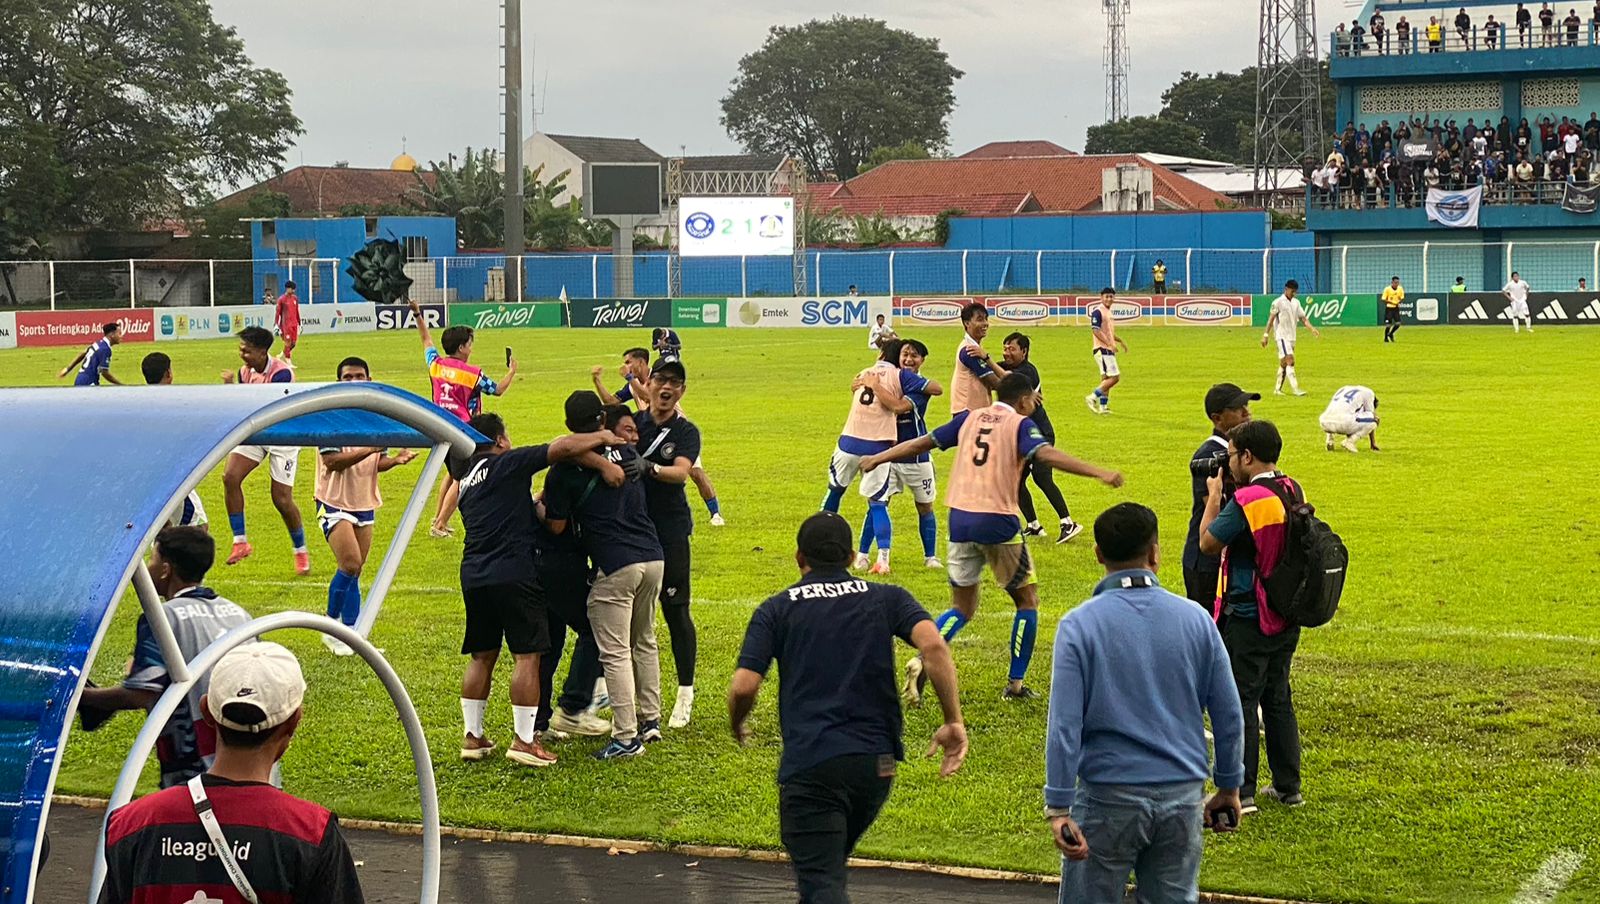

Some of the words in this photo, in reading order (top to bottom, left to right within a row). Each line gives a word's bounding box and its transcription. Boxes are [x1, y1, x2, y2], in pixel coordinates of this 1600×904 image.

[722, 218, 732, 235] 2
[745, 218, 752, 234] 1
[762, 308, 789, 317] Emtek
[801, 300, 868, 325] SCM
[914, 306, 959, 316] Indomaret
[1000, 305, 1045, 316] Indomaret
[1180, 306, 1227, 316] Indomaret
[190, 318, 210, 329] PLN
[344, 315, 372, 324] PERTAMINA
[378, 309, 440, 329] SIAR
[19, 324, 46, 336] Sports
[47, 323, 90, 336] Terlengkap
[116, 317, 151, 336] Vidio
[972, 428, 993, 466] 5
[922, 478, 932, 490] 97
[788, 580, 869, 601] PERSIKU
[174, 603, 215, 620] BALL
